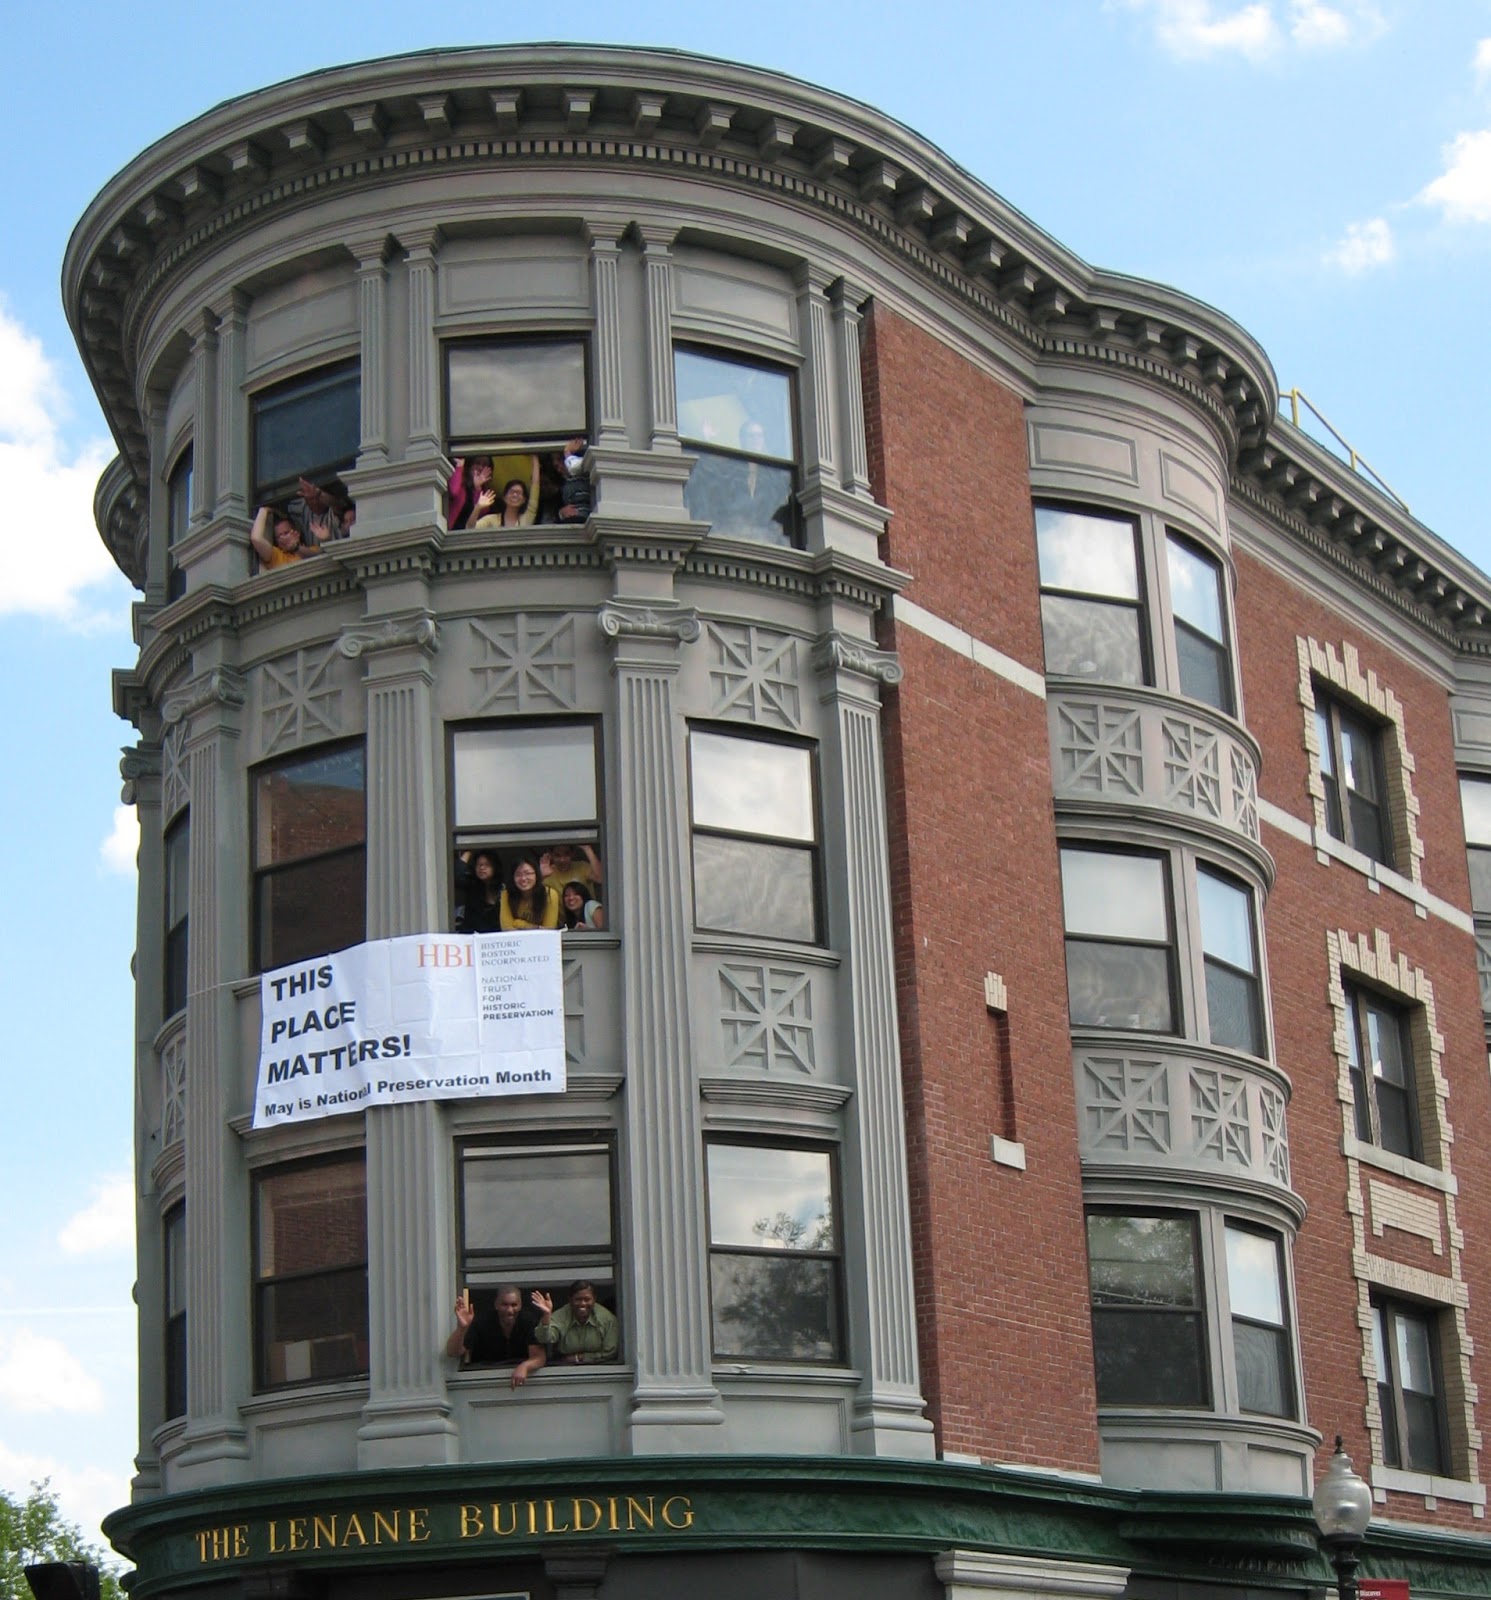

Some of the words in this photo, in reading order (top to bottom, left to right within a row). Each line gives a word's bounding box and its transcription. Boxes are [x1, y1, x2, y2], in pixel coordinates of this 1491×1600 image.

[481, 940, 522, 950] HISTORIC
[418, 944, 474, 968] HBI
[481, 949, 516, 959] BOSTON
[481, 955, 550, 967] INCORPORATED
[271, 965, 333, 1002] THIS
[481, 974, 529, 984] NATIONAL
[482, 984, 513, 993] TRUST
[482, 994, 502, 1002] FOR
[482, 1002, 526, 1012] HISTORIC
[483, 1008, 554, 1021] PRESERVATION
[271, 1001, 356, 1044] PLACE
[268, 1034, 411, 1084] MATTERS!
[265, 1102, 294, 1117] May
[298, 1097, 312, 1110] is
[377, 1074, 490, 1094] Preservation
[496, 1068, 552, 1084] Month
[195, 1524, 250, 1563] THE
[268, 1507, 432, 1554] LENANE
[459, 1495, 696, 1539] BUILDING
